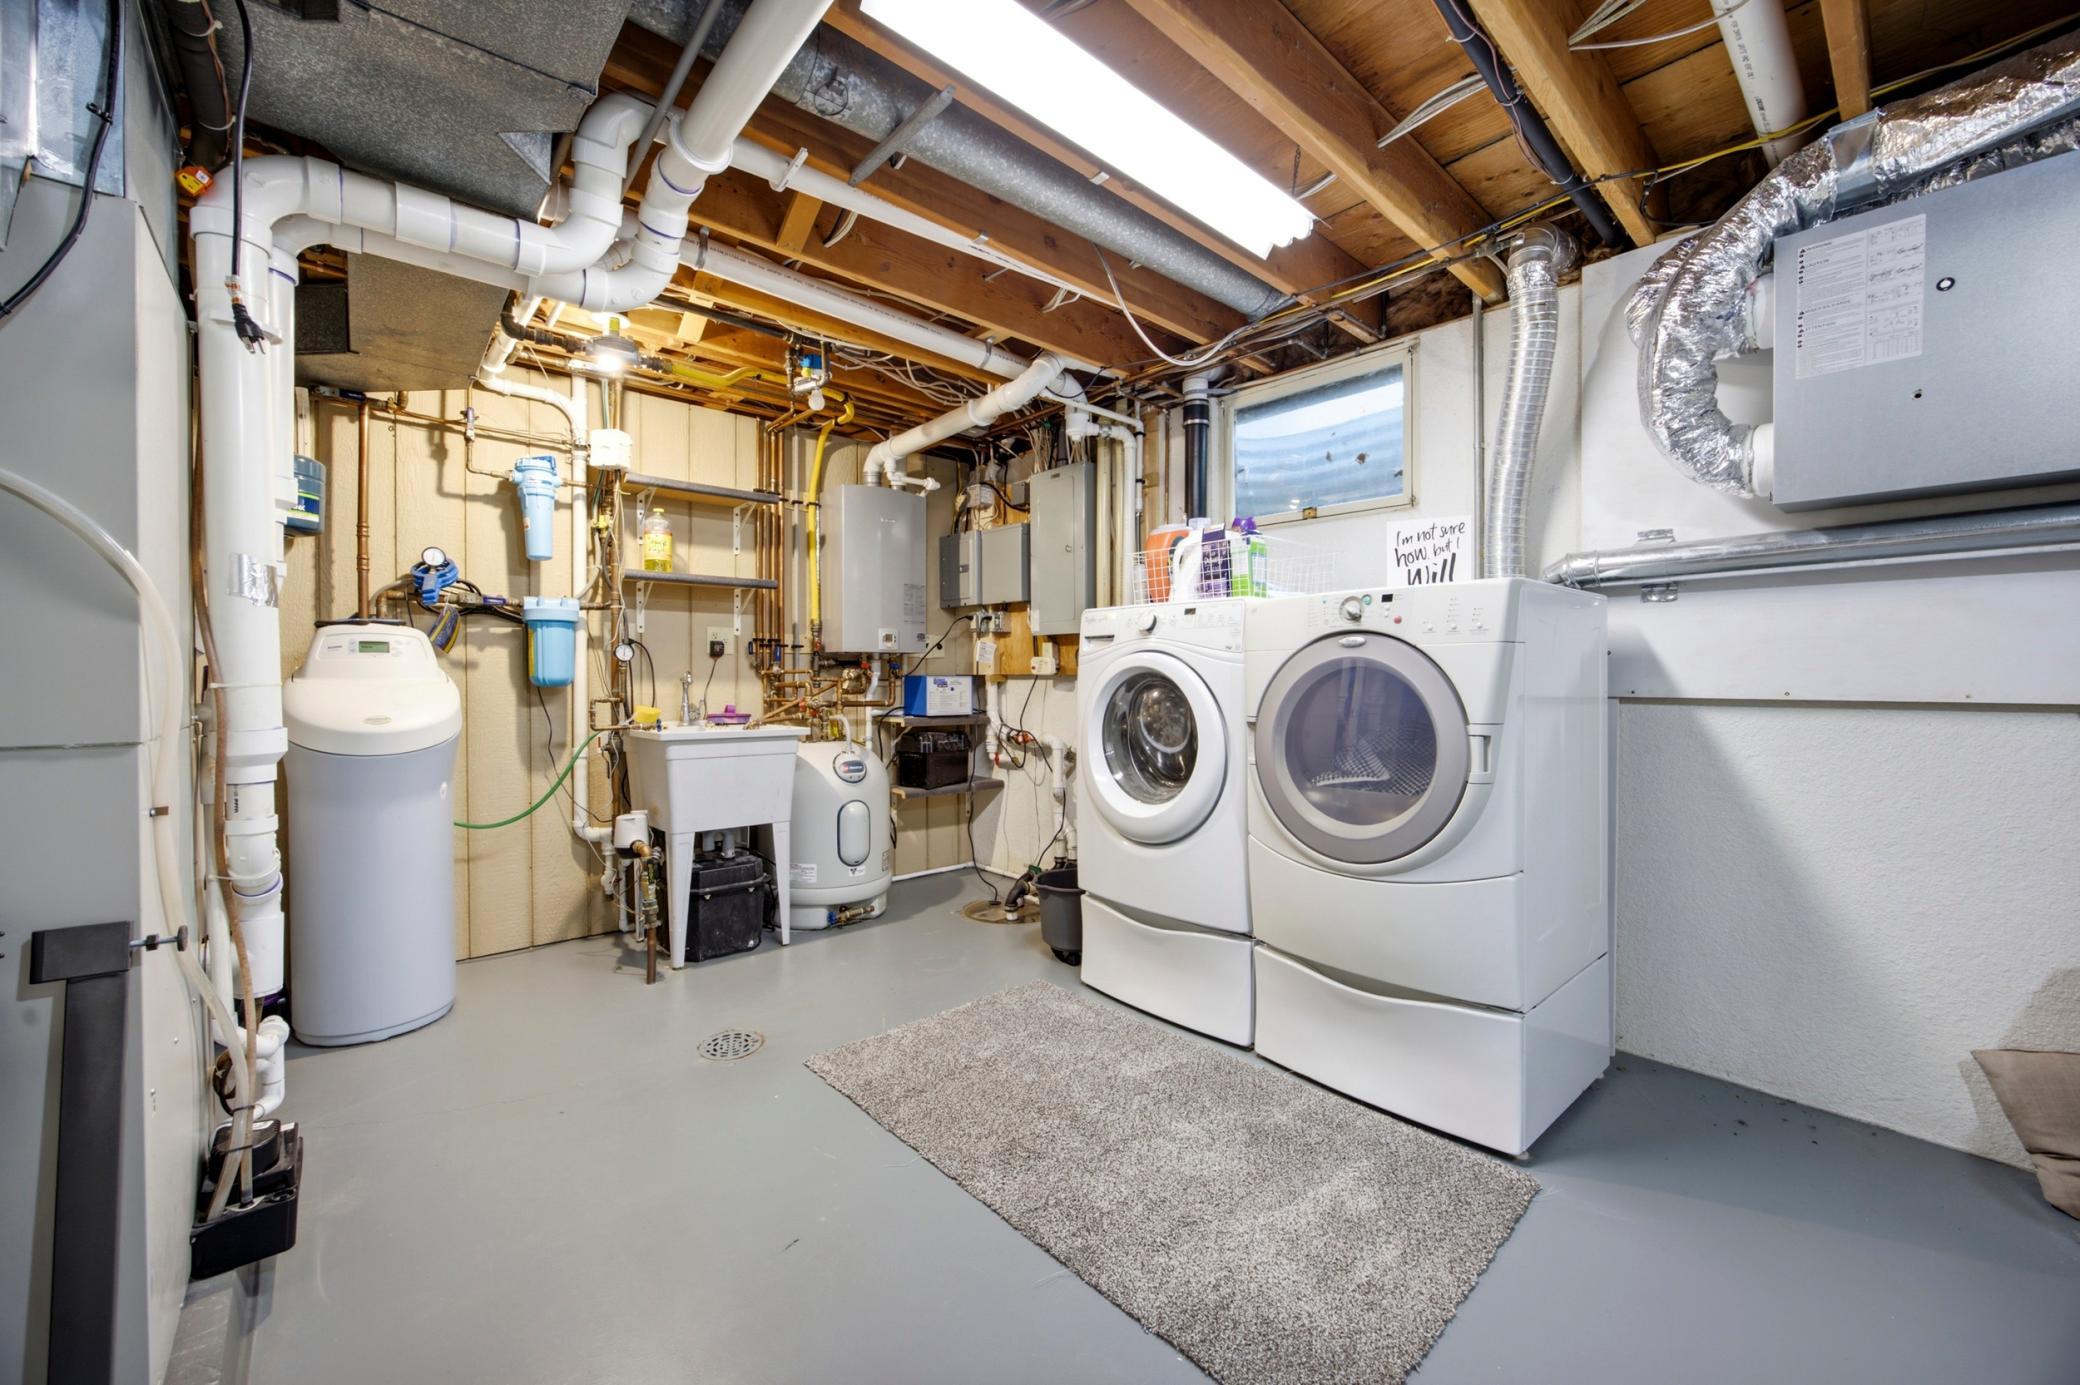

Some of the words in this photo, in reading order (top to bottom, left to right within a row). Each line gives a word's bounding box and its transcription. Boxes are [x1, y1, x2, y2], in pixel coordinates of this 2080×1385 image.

[1417, 522, 1437, 541] not
[1440, 522, 1465, 538] sure
[1433, 538, 1452, 556] but
